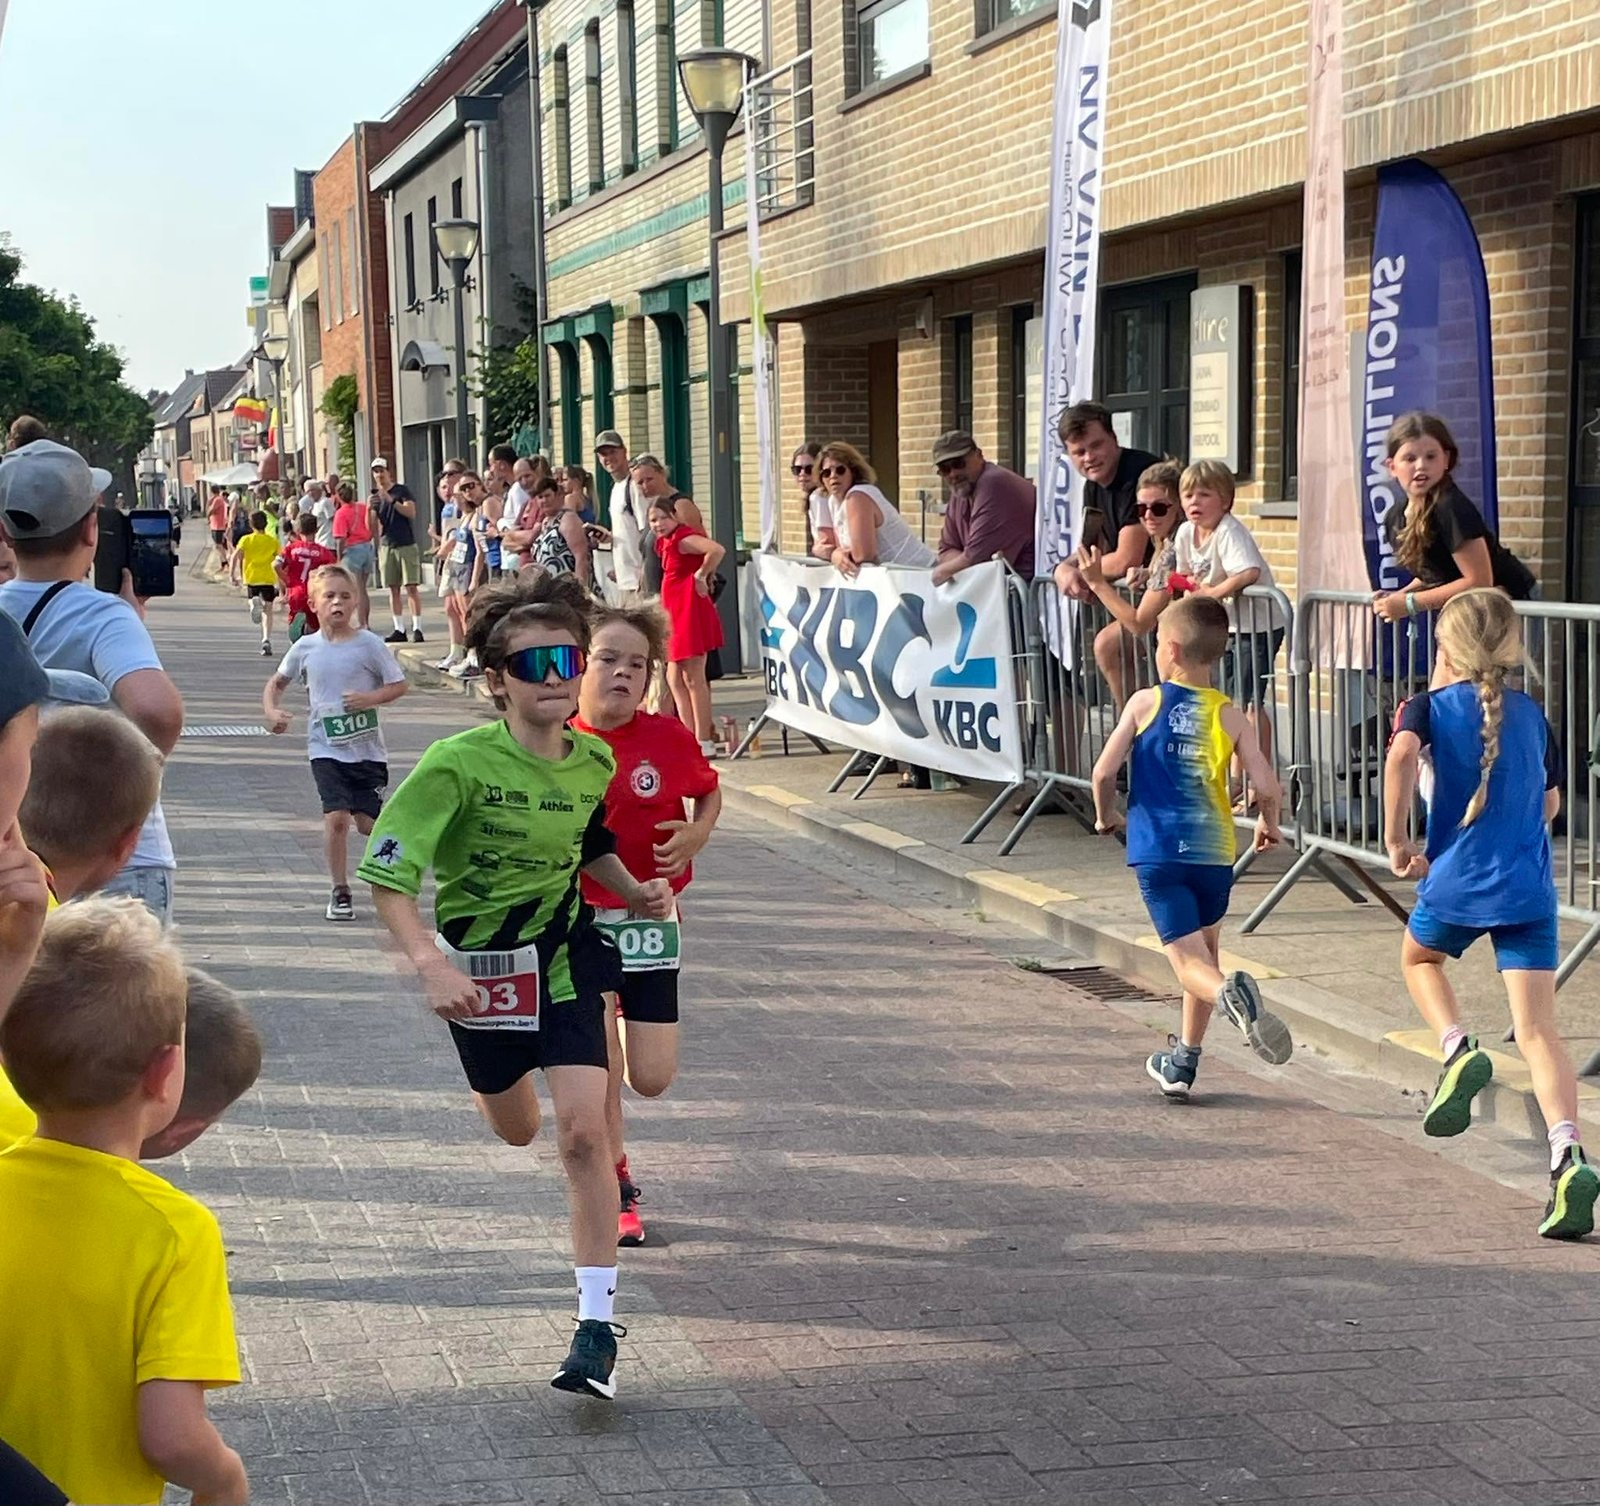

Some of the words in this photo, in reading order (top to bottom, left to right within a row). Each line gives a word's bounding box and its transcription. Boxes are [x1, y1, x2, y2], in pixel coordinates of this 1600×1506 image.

[298, 556, 312, 580] 7
[787, 585, 933, 739] KBC
[332, 712, 368, 736] 310
[933, 698, 1002, 753] KBC
